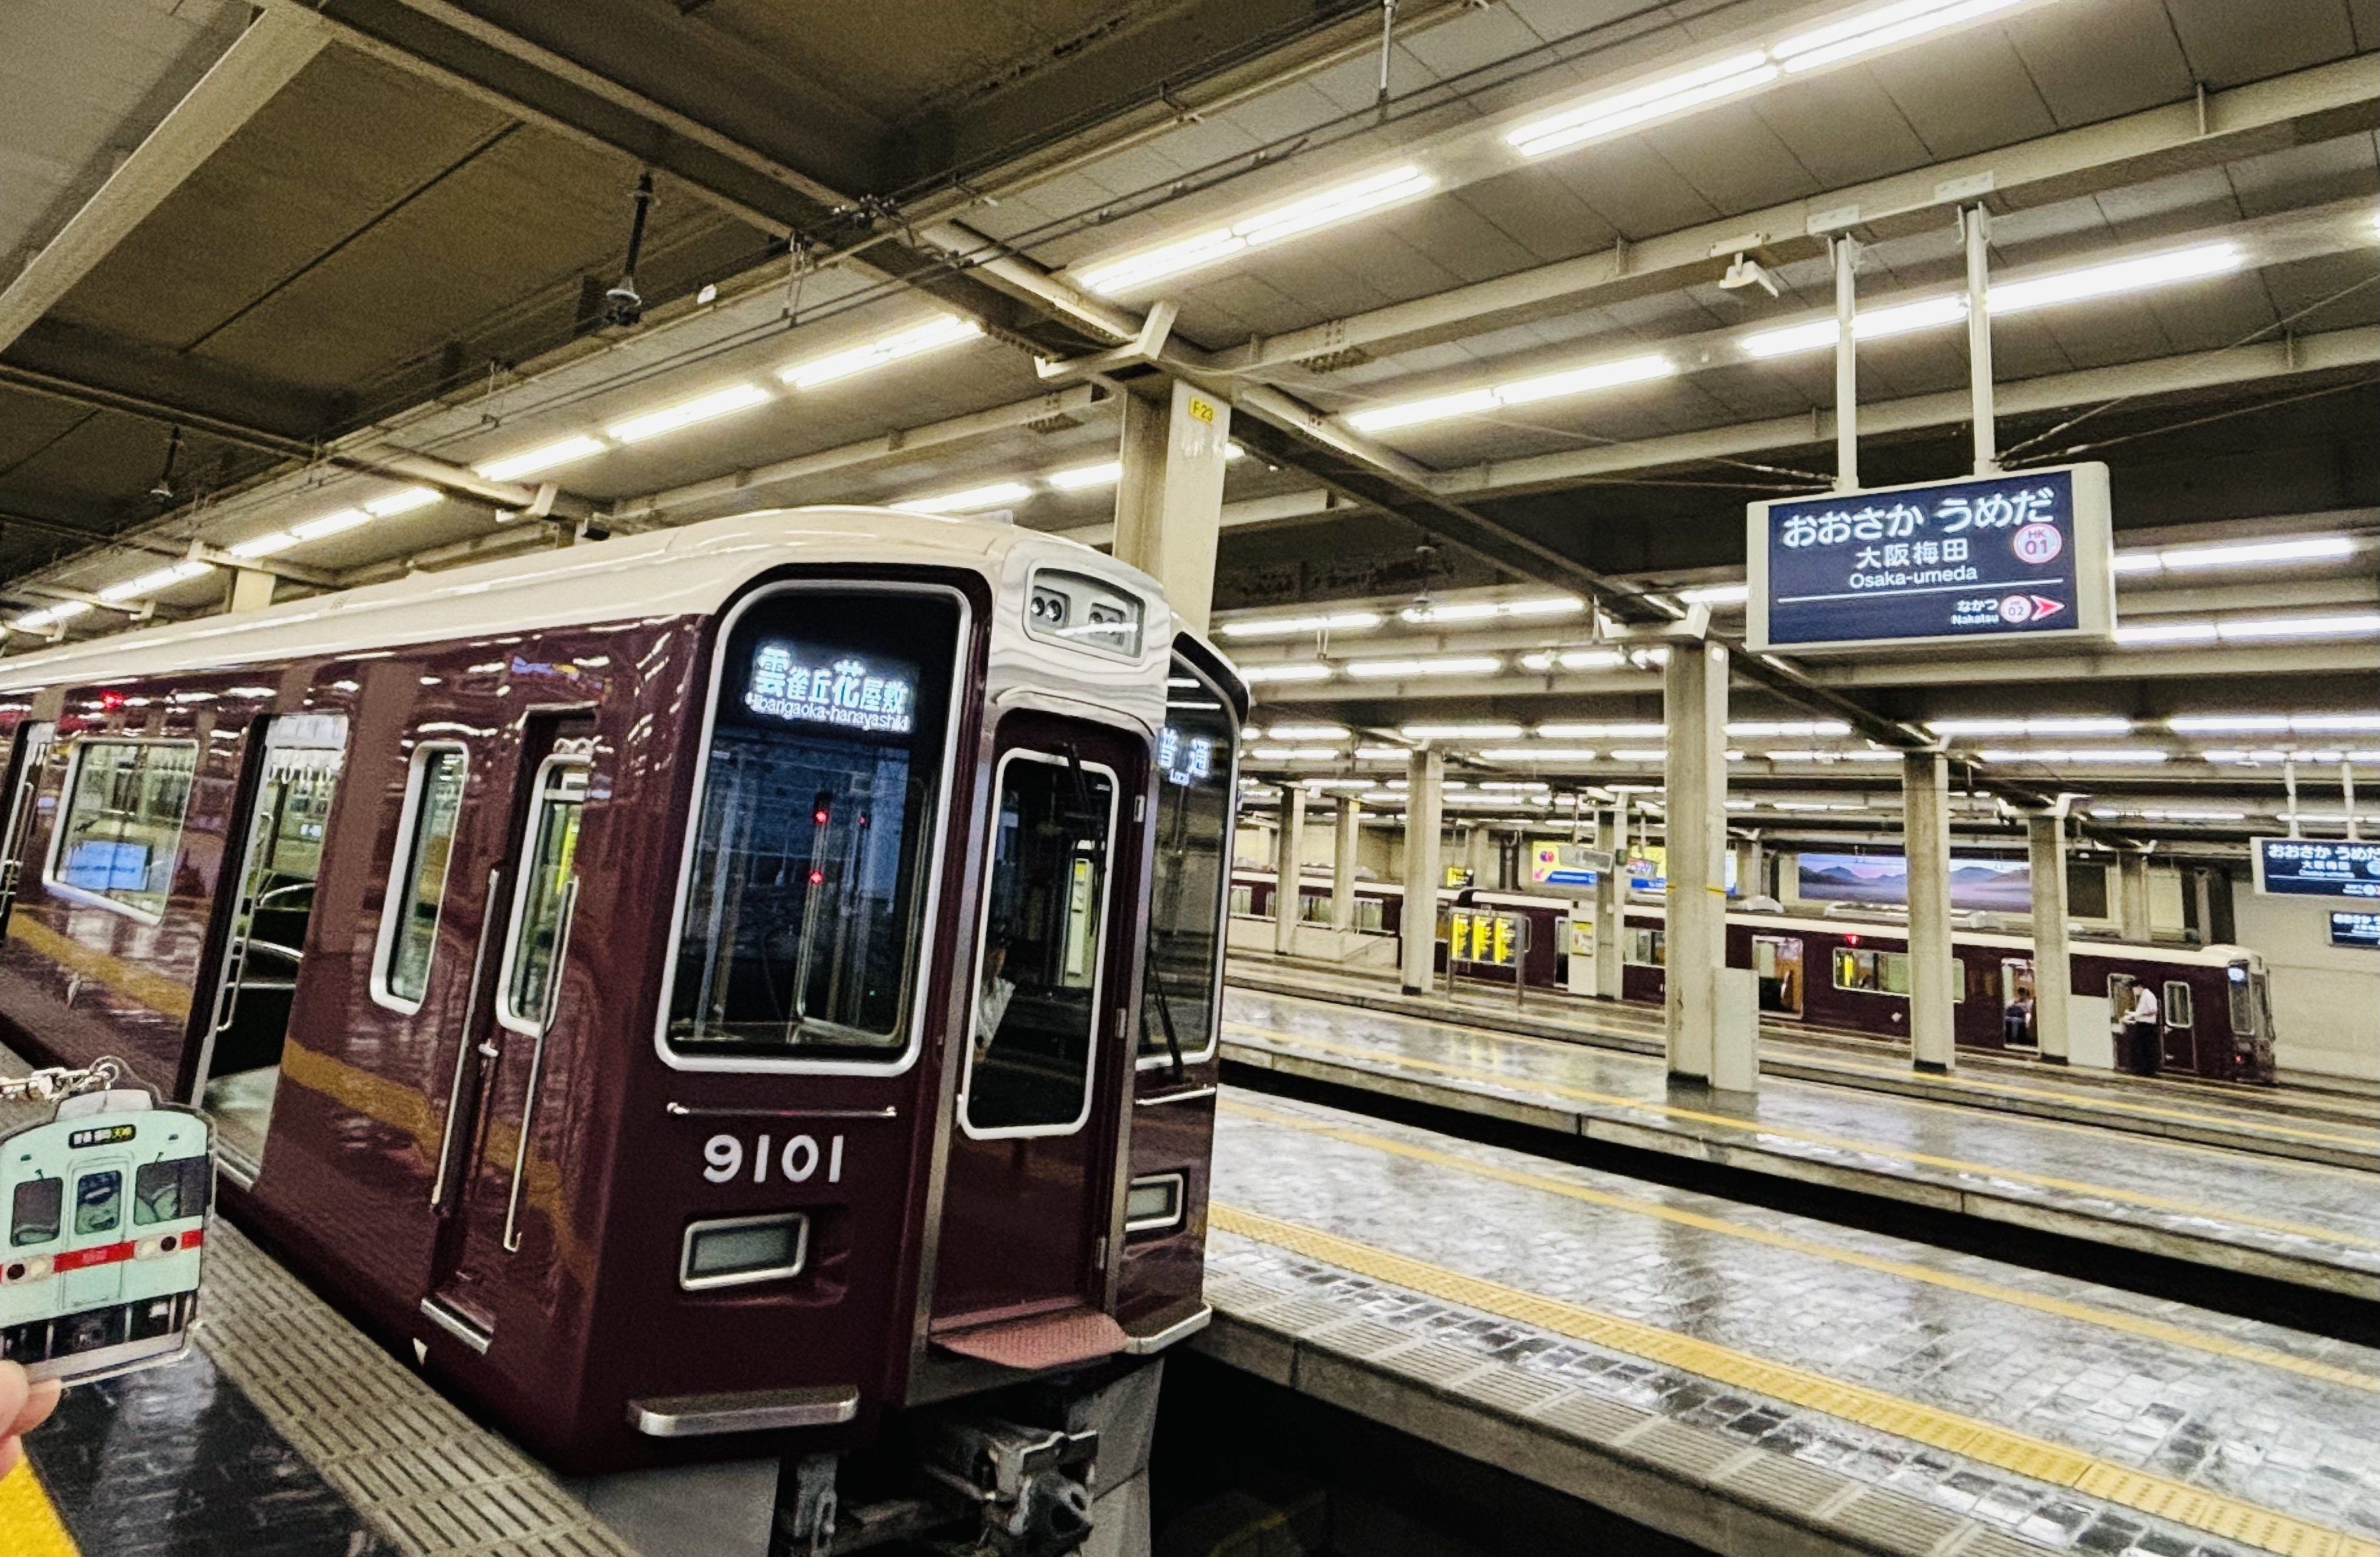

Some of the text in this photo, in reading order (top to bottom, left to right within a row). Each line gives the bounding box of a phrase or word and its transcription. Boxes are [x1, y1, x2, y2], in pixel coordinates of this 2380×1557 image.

[1783, 486, 2055, 548] おおさか うめだ
[2028, 529, 2047, 539] HK
[1855, 538, 1968, 569] 大阪梅田
[2025, 540, 2048, 555] 01
[1850, 565, 1978, 589] Osaka-umeda
[1956, 598, 1998, 613] なかつ
[2008, 607, 2024, 616] 02
[1951, 614, 1999, 625] Nakatsu
[756, 646, 909, 714] 雲雀丘花屋敷
[2268, 844, 2331, 859] おおさか
[703, 1134, 844, 1183] 9101
